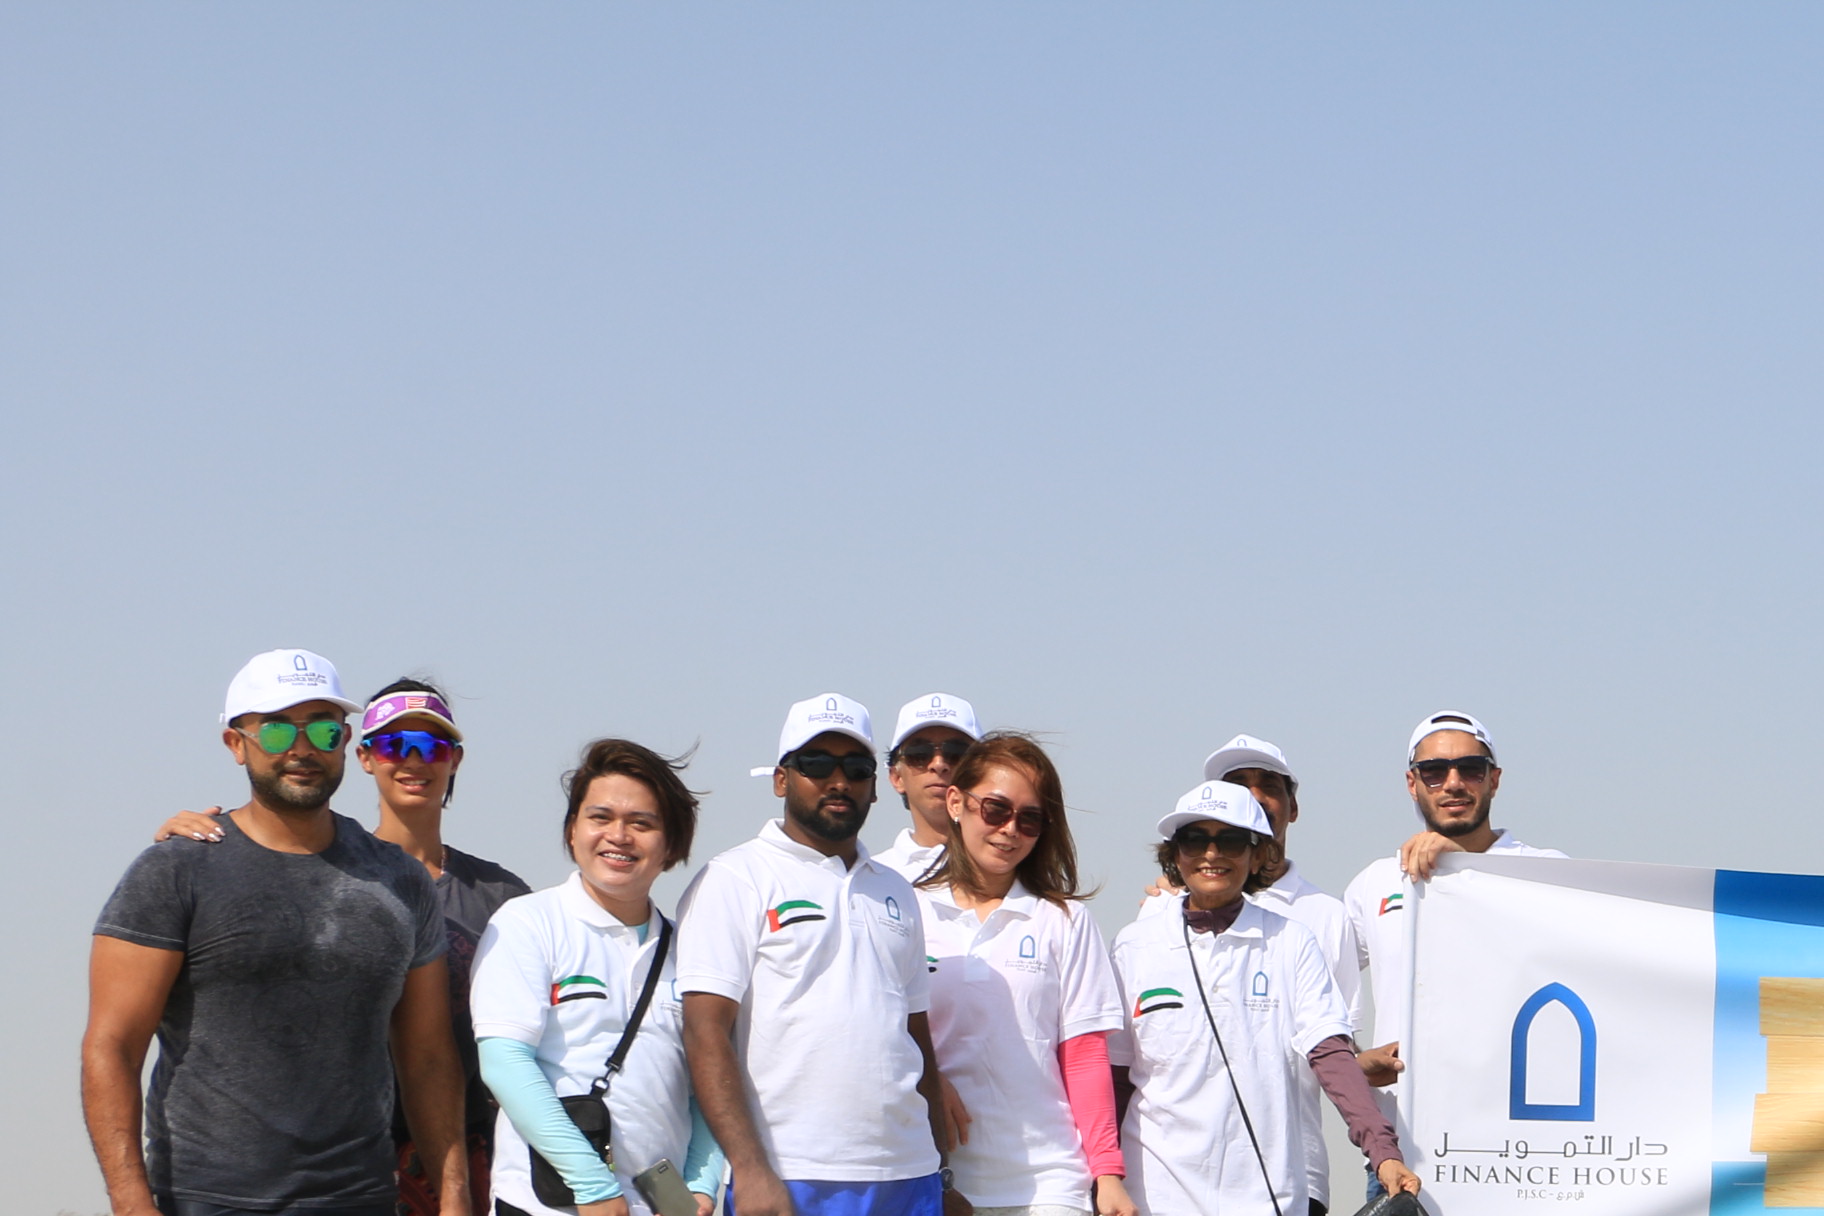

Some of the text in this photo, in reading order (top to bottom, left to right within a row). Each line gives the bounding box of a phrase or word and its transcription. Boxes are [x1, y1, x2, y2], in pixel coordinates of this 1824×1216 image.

[1614, 1135, 1668, 1162] دار
[1434, 1163, 1668, 1186] FINANCE HOUSE
